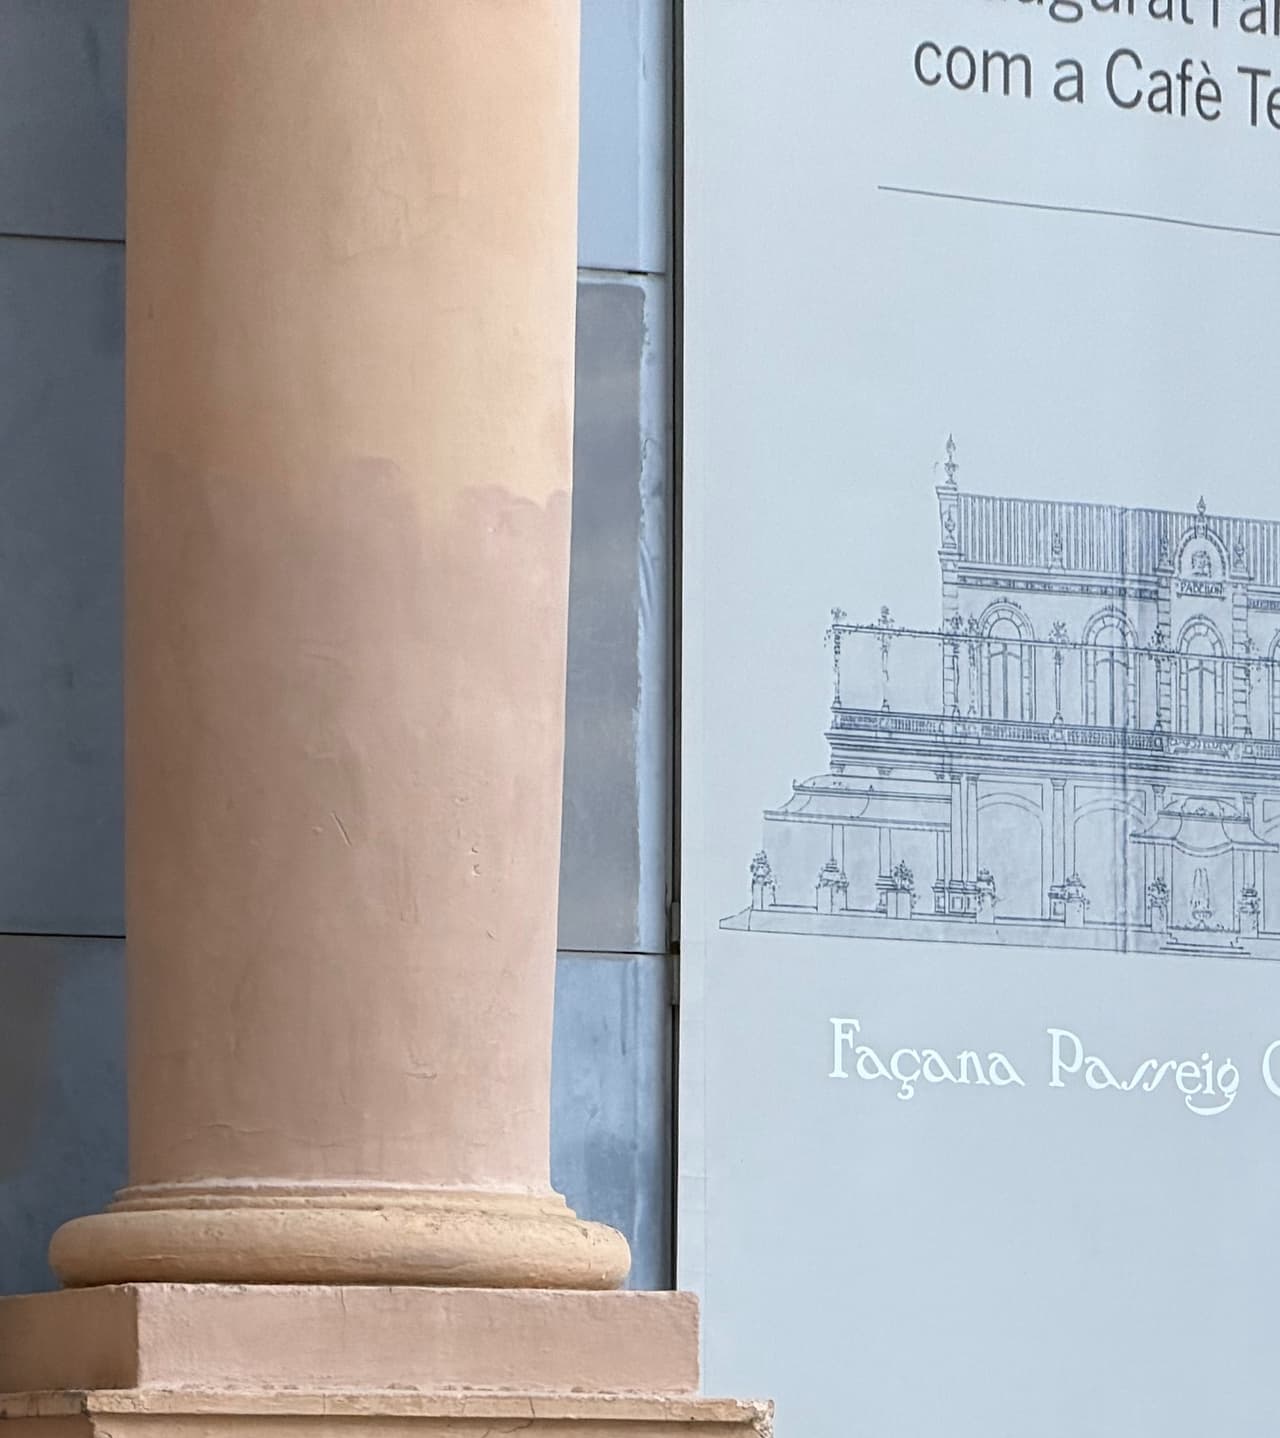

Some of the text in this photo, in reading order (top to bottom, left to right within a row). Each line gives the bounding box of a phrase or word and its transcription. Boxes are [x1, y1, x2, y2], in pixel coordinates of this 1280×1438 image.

[914, 41, 1032, 98] com
[1053, 58, 1085, 104] a
[1105, 48, 1222, 121] Cafè
[828, 1017, 1026, 1100] Façana
[1046, 1028, 1240, 1116] Passeig
